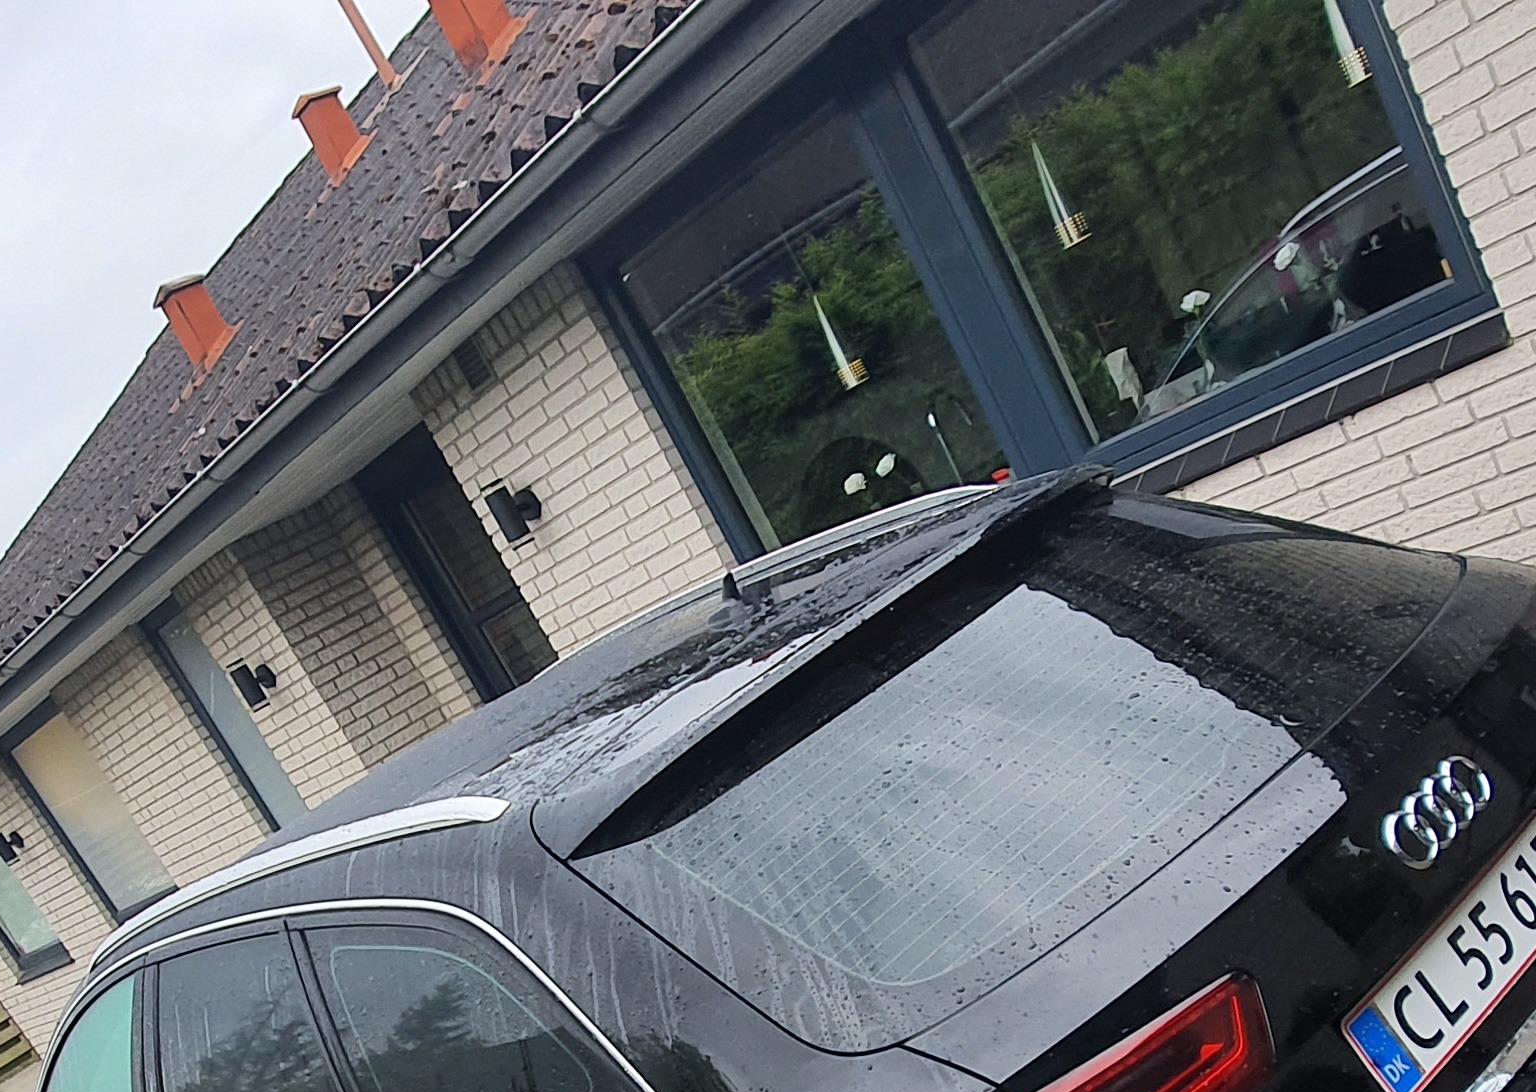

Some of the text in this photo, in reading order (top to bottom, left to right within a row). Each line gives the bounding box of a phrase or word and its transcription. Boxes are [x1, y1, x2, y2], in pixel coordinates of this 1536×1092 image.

[1393, 970, 1470, 1049] CL
[1447, 901, 1513, 990] 55
[1384, 1054, 1411, 1084] DK
